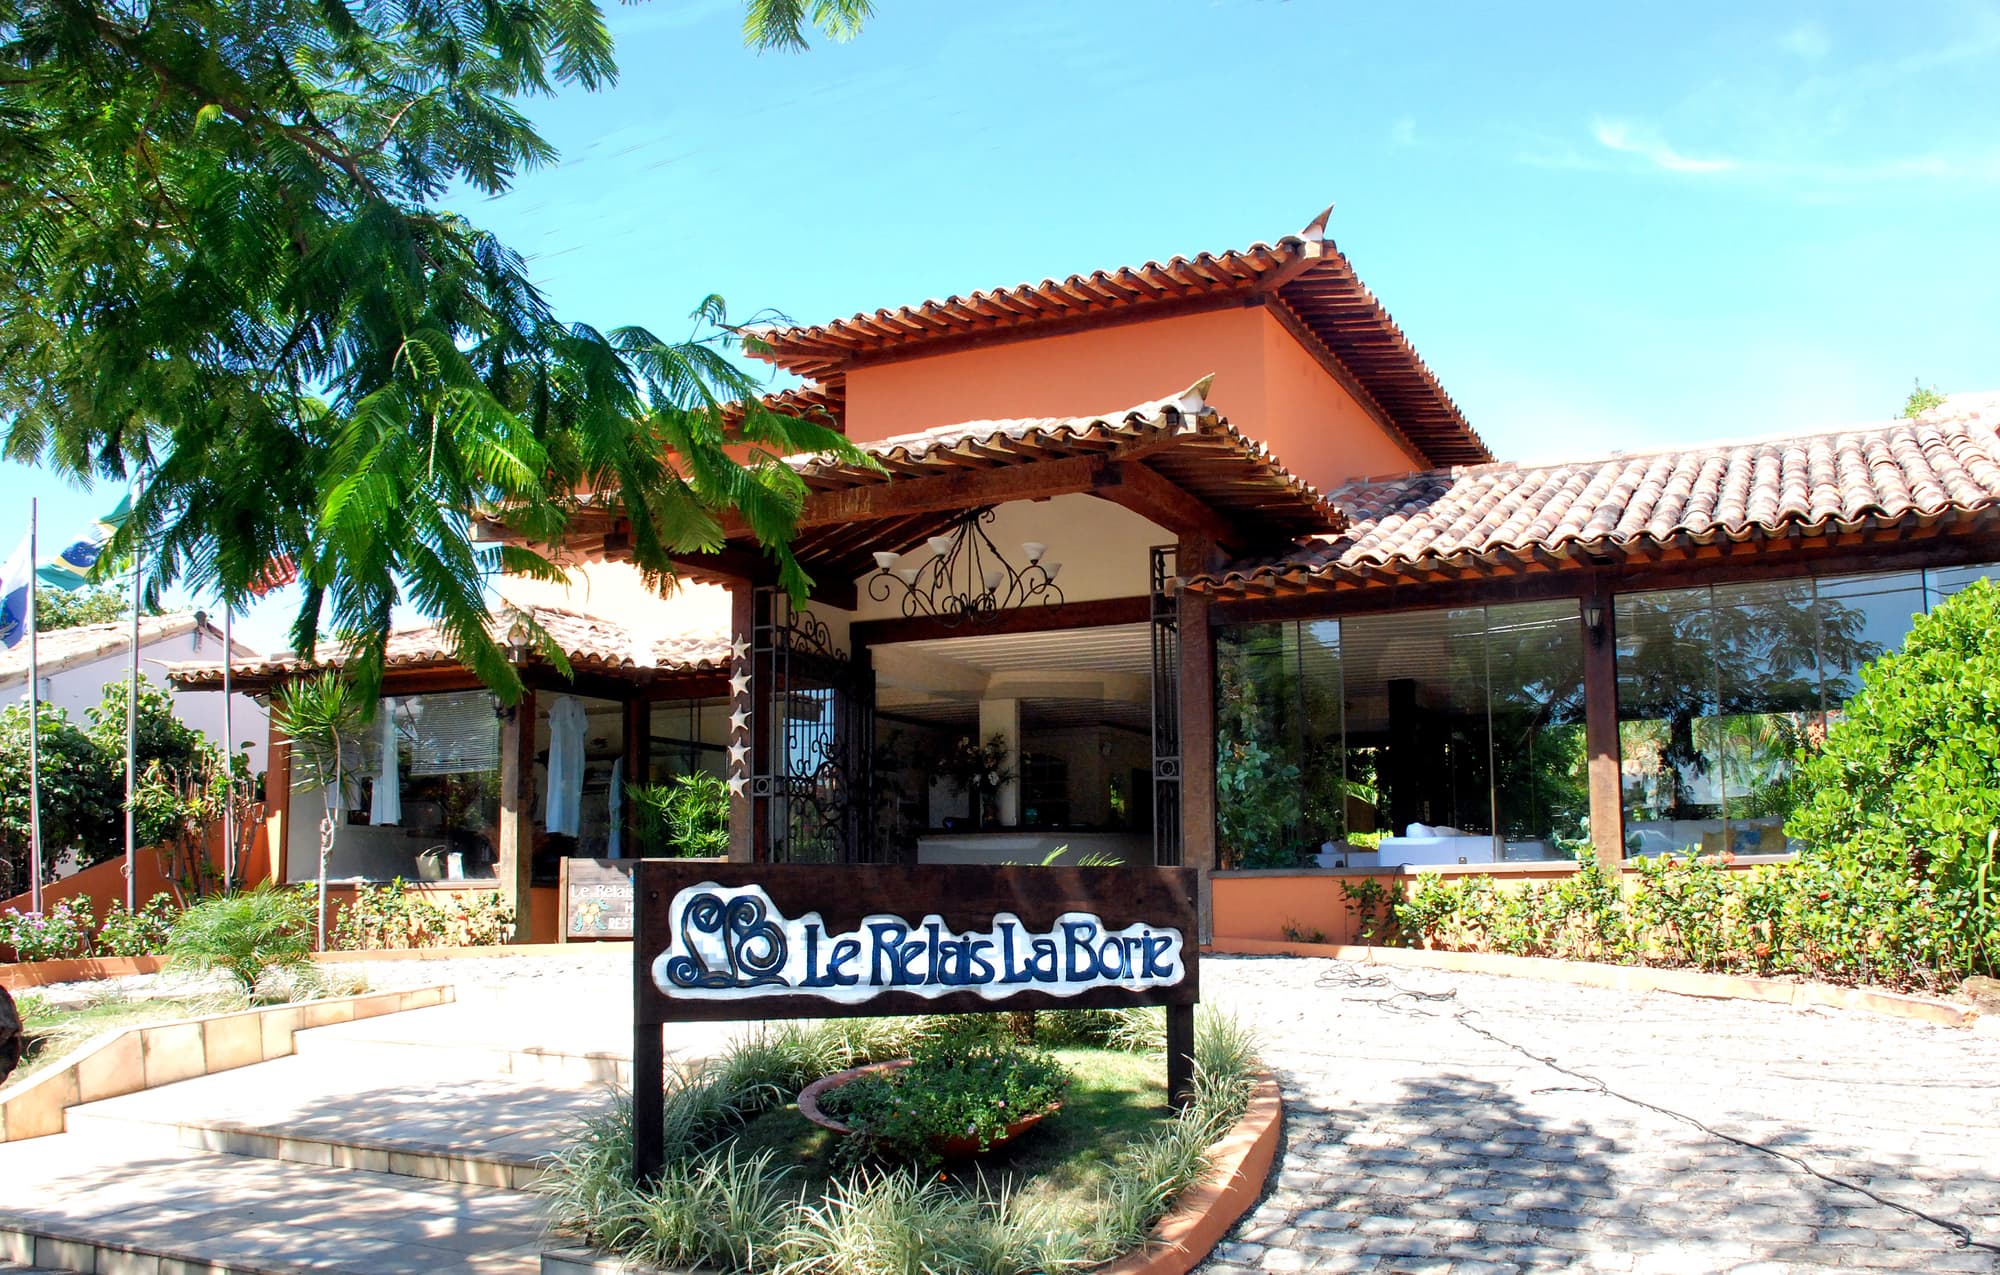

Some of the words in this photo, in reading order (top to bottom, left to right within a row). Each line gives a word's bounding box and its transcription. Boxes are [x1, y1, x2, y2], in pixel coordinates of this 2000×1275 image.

[571, 884, 590, 898] Le
[798, 924, 860, 987] Le
[867, 922, 996, 986] Relais
[997, 922, 1058, 984] La
[1060, 921, 1175, 983] Borie
